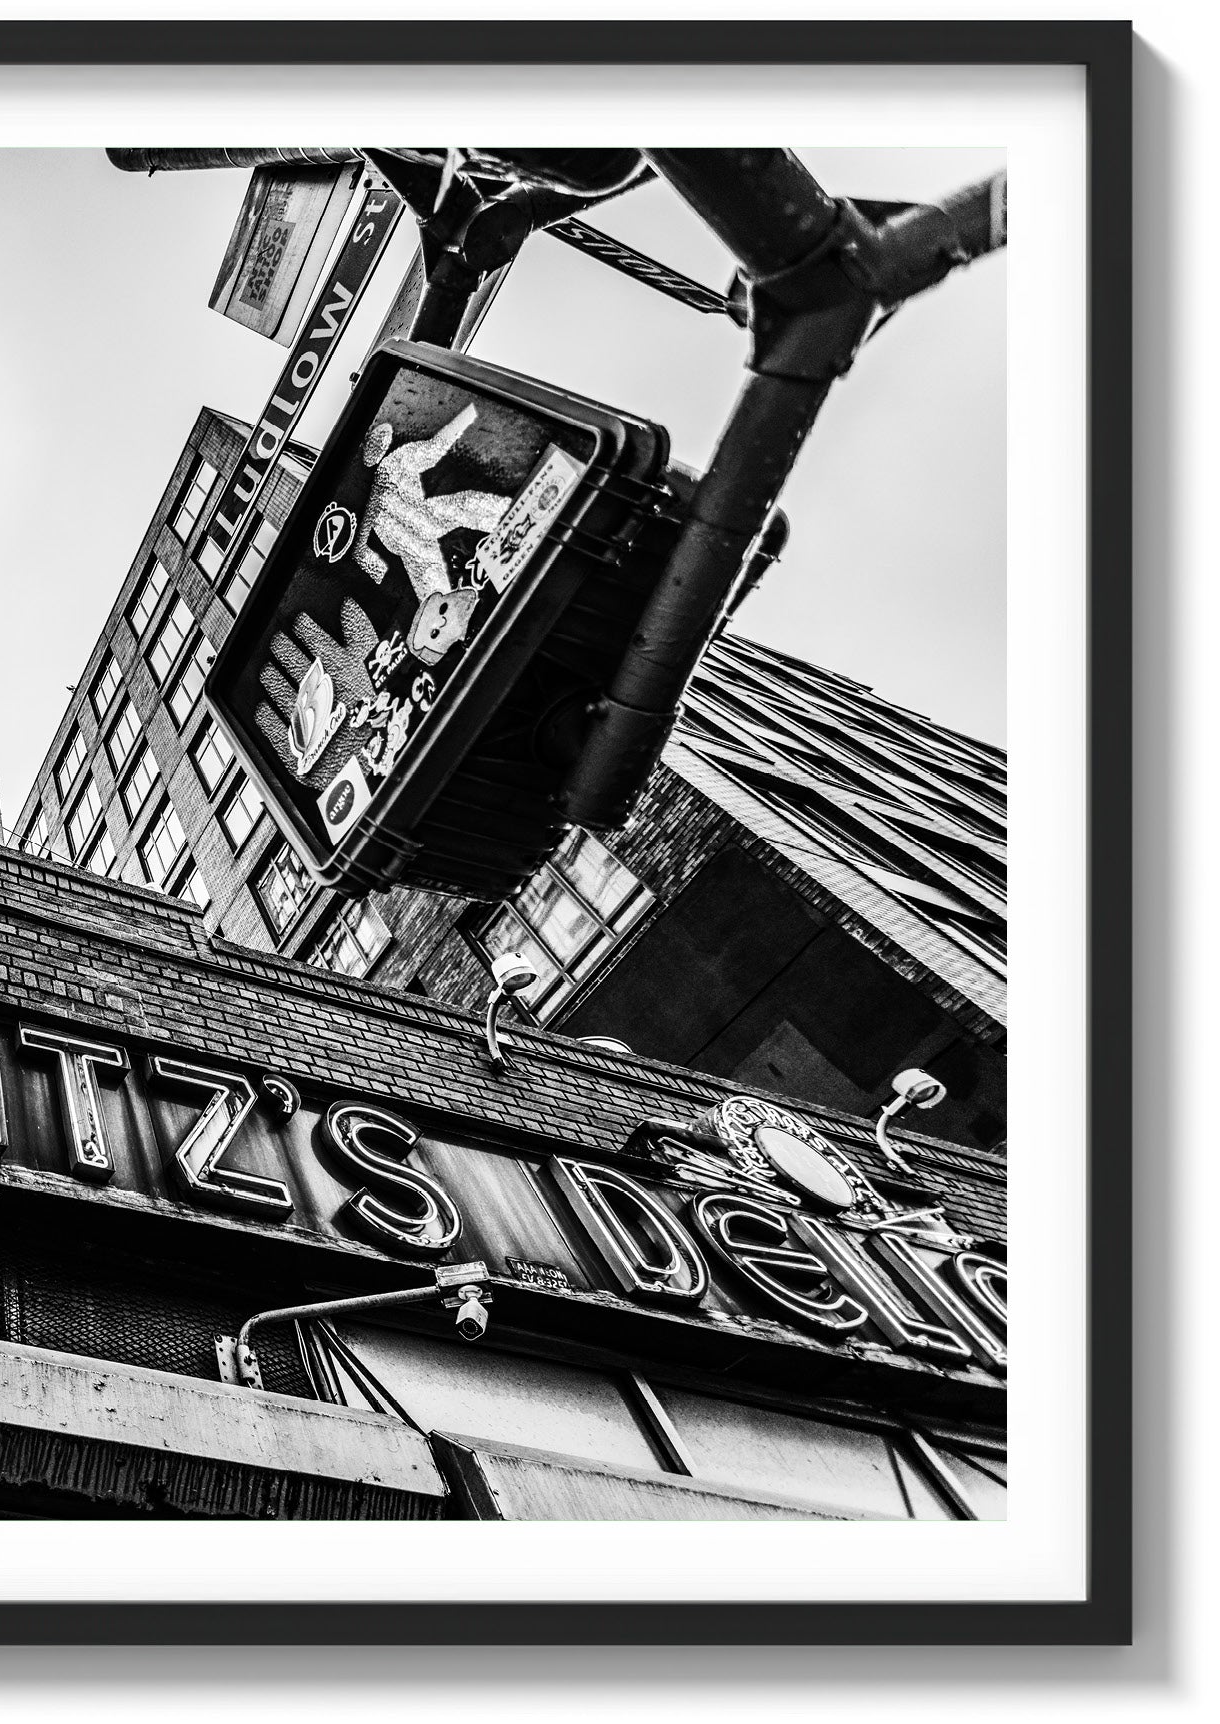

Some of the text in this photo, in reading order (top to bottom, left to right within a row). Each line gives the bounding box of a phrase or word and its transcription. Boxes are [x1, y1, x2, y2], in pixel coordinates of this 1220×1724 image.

[249, 227, 281, 299] TATTOO
[258, 228, 289, 303] SHOP
[555, 220, 703, 293] HOUS
[215, 281, 353, 537] Ludlow
[353, 199, 388, 246] St
[386, 647, 408, 675] PAULI
